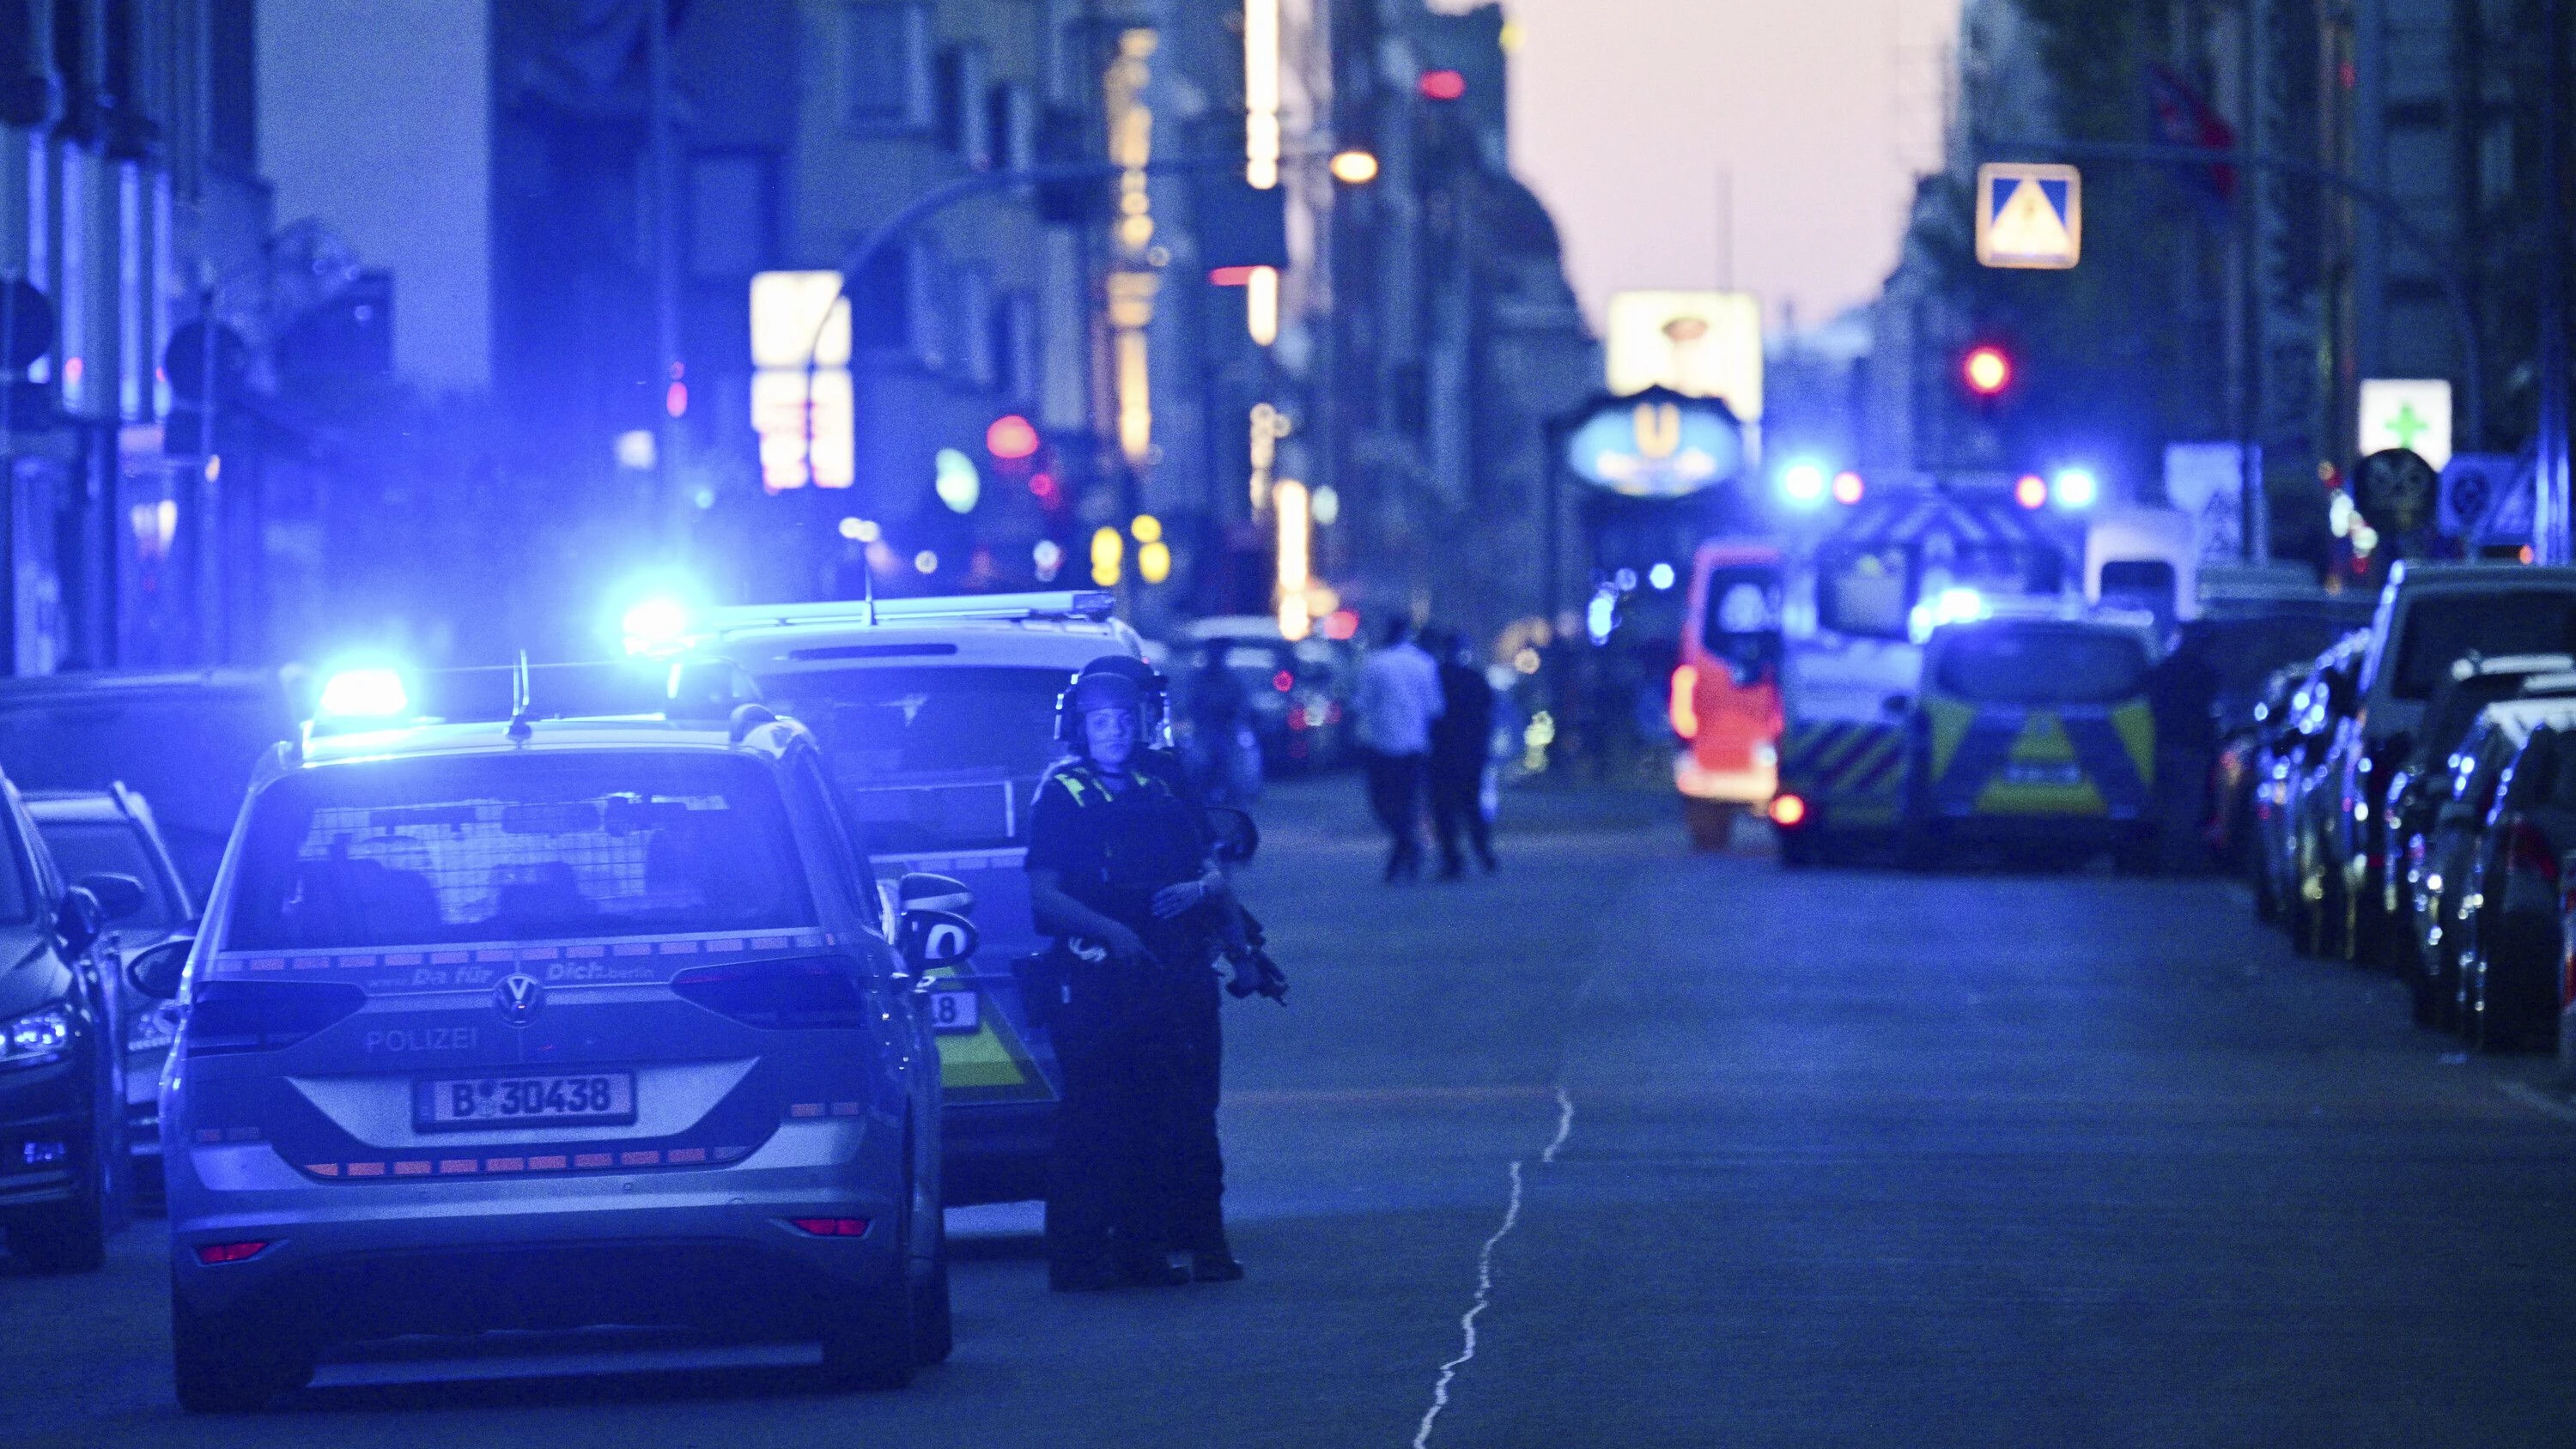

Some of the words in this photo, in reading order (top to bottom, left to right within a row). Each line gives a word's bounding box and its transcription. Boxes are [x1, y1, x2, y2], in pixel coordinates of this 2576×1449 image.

[1633, 402, 1680, 458] U
[454, 965, 494, 985] für
[934, 996, 957, 1023] 8
[366, 1026, 478, 1053] POLIZEI
[452, 1083, 476, 1118] B
[500, 1076, 611, 1115] 30438
